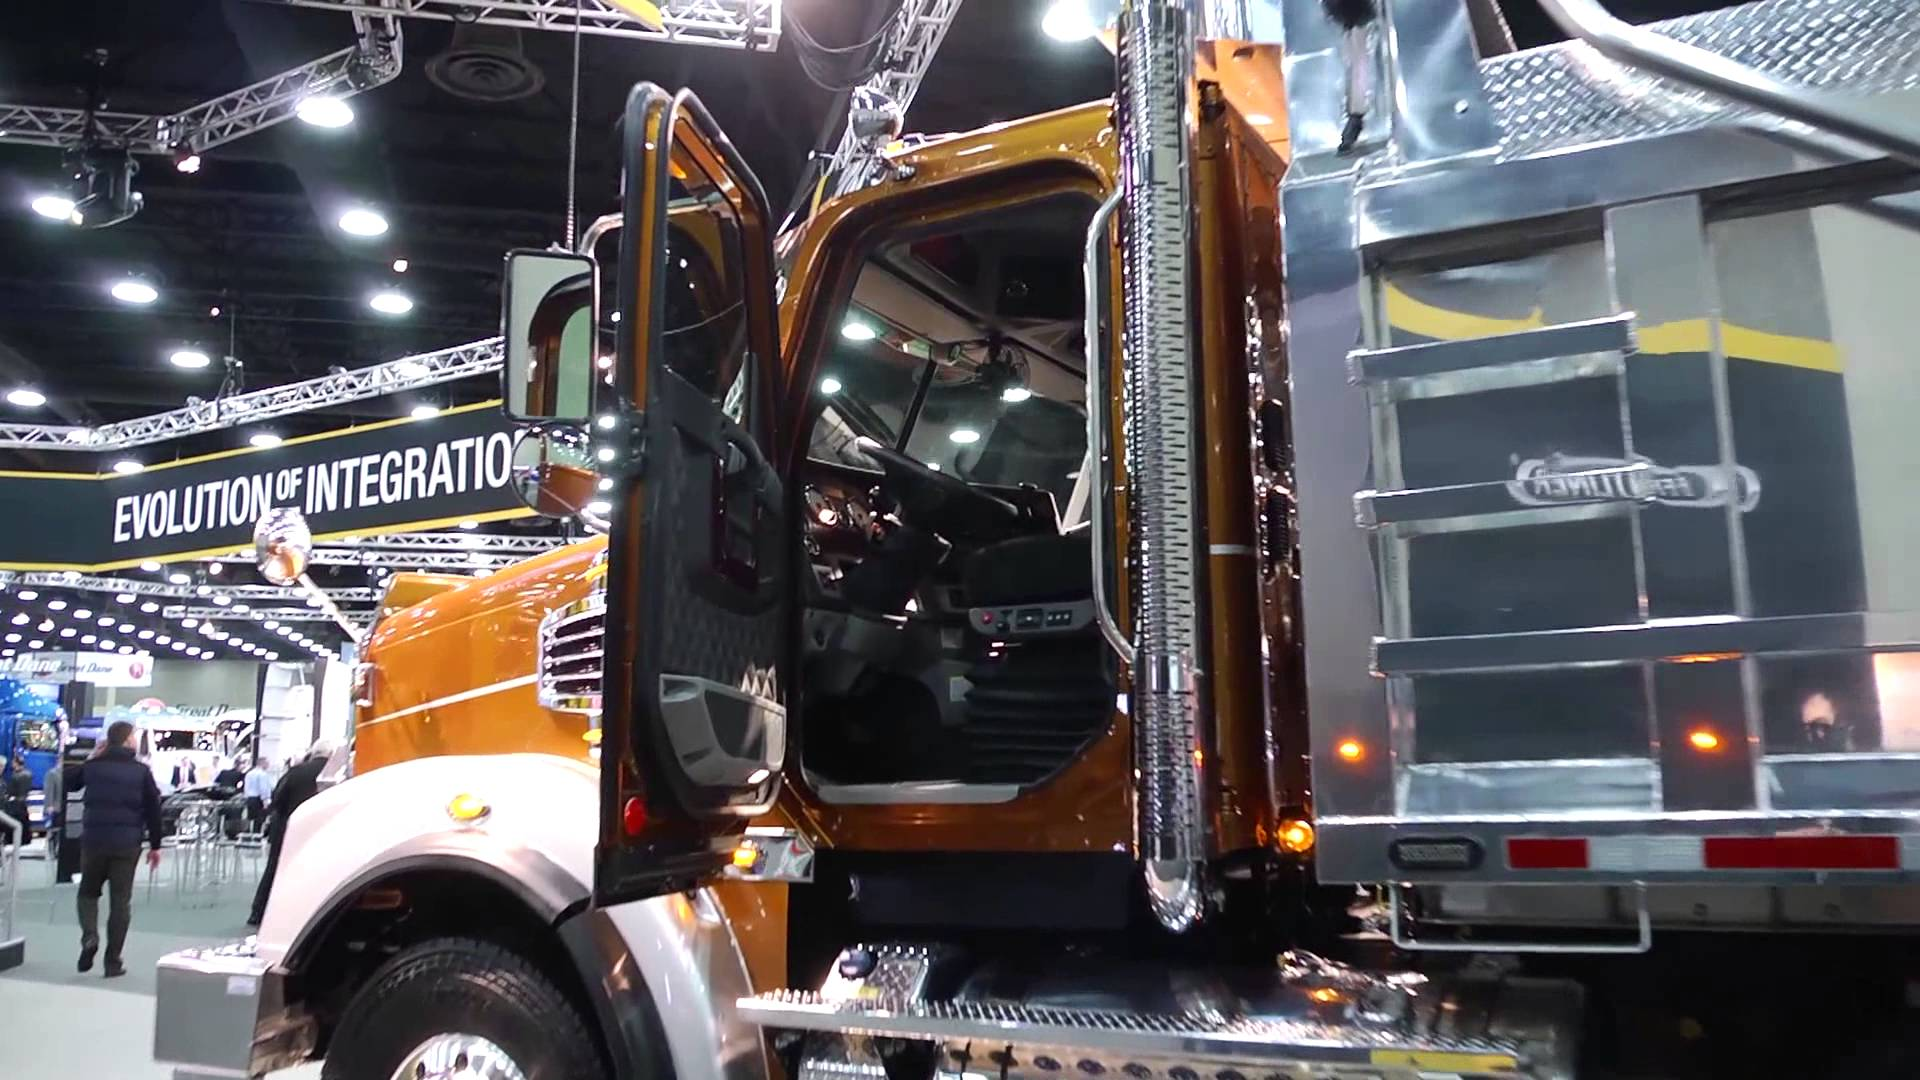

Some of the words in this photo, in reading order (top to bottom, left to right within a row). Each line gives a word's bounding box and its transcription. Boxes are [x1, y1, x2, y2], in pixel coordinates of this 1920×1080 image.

[113, 474, 273, 544] EVOLUTION
[276, 467, 303, 501] OF
[306, 430, 526, 514] INTEGRATIO
